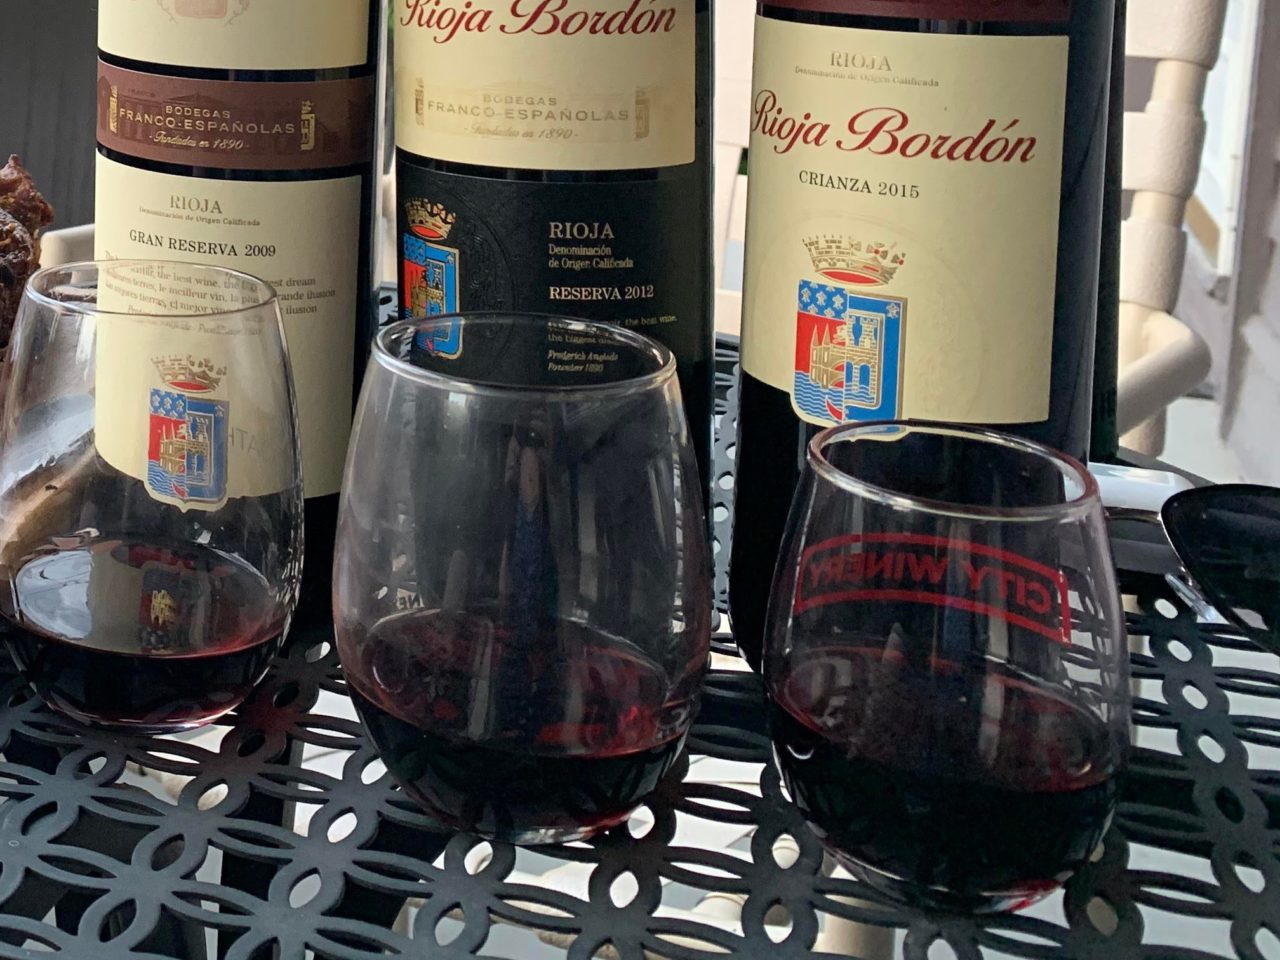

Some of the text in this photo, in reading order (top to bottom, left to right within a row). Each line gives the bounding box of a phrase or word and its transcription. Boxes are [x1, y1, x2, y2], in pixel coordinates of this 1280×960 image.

[830, 50, 892, 71] RIOJA
[483, 93, 557, 106] BODEGAS
[165, 105, 231, 119] BODEGAS
[538, 127, 573, 139] 1890
[752, 90, 1038, 163] Rioja Bordón
[213, 138, 244, 151] 1890
[798, 170, 920, 199] CRIANZA 2015
[170, 195, 223, 214] RIOJA
[549, 222, 615, 239] RIOJA
[129, 229, 276, 257] GRAN RESERVA 2009
[548, 243, 612, 256] Denominación
[548, 258, 559, 268] de
[286, 278, 316, 287] dream
[549, 284, 655, 300] RESERVA 2012
